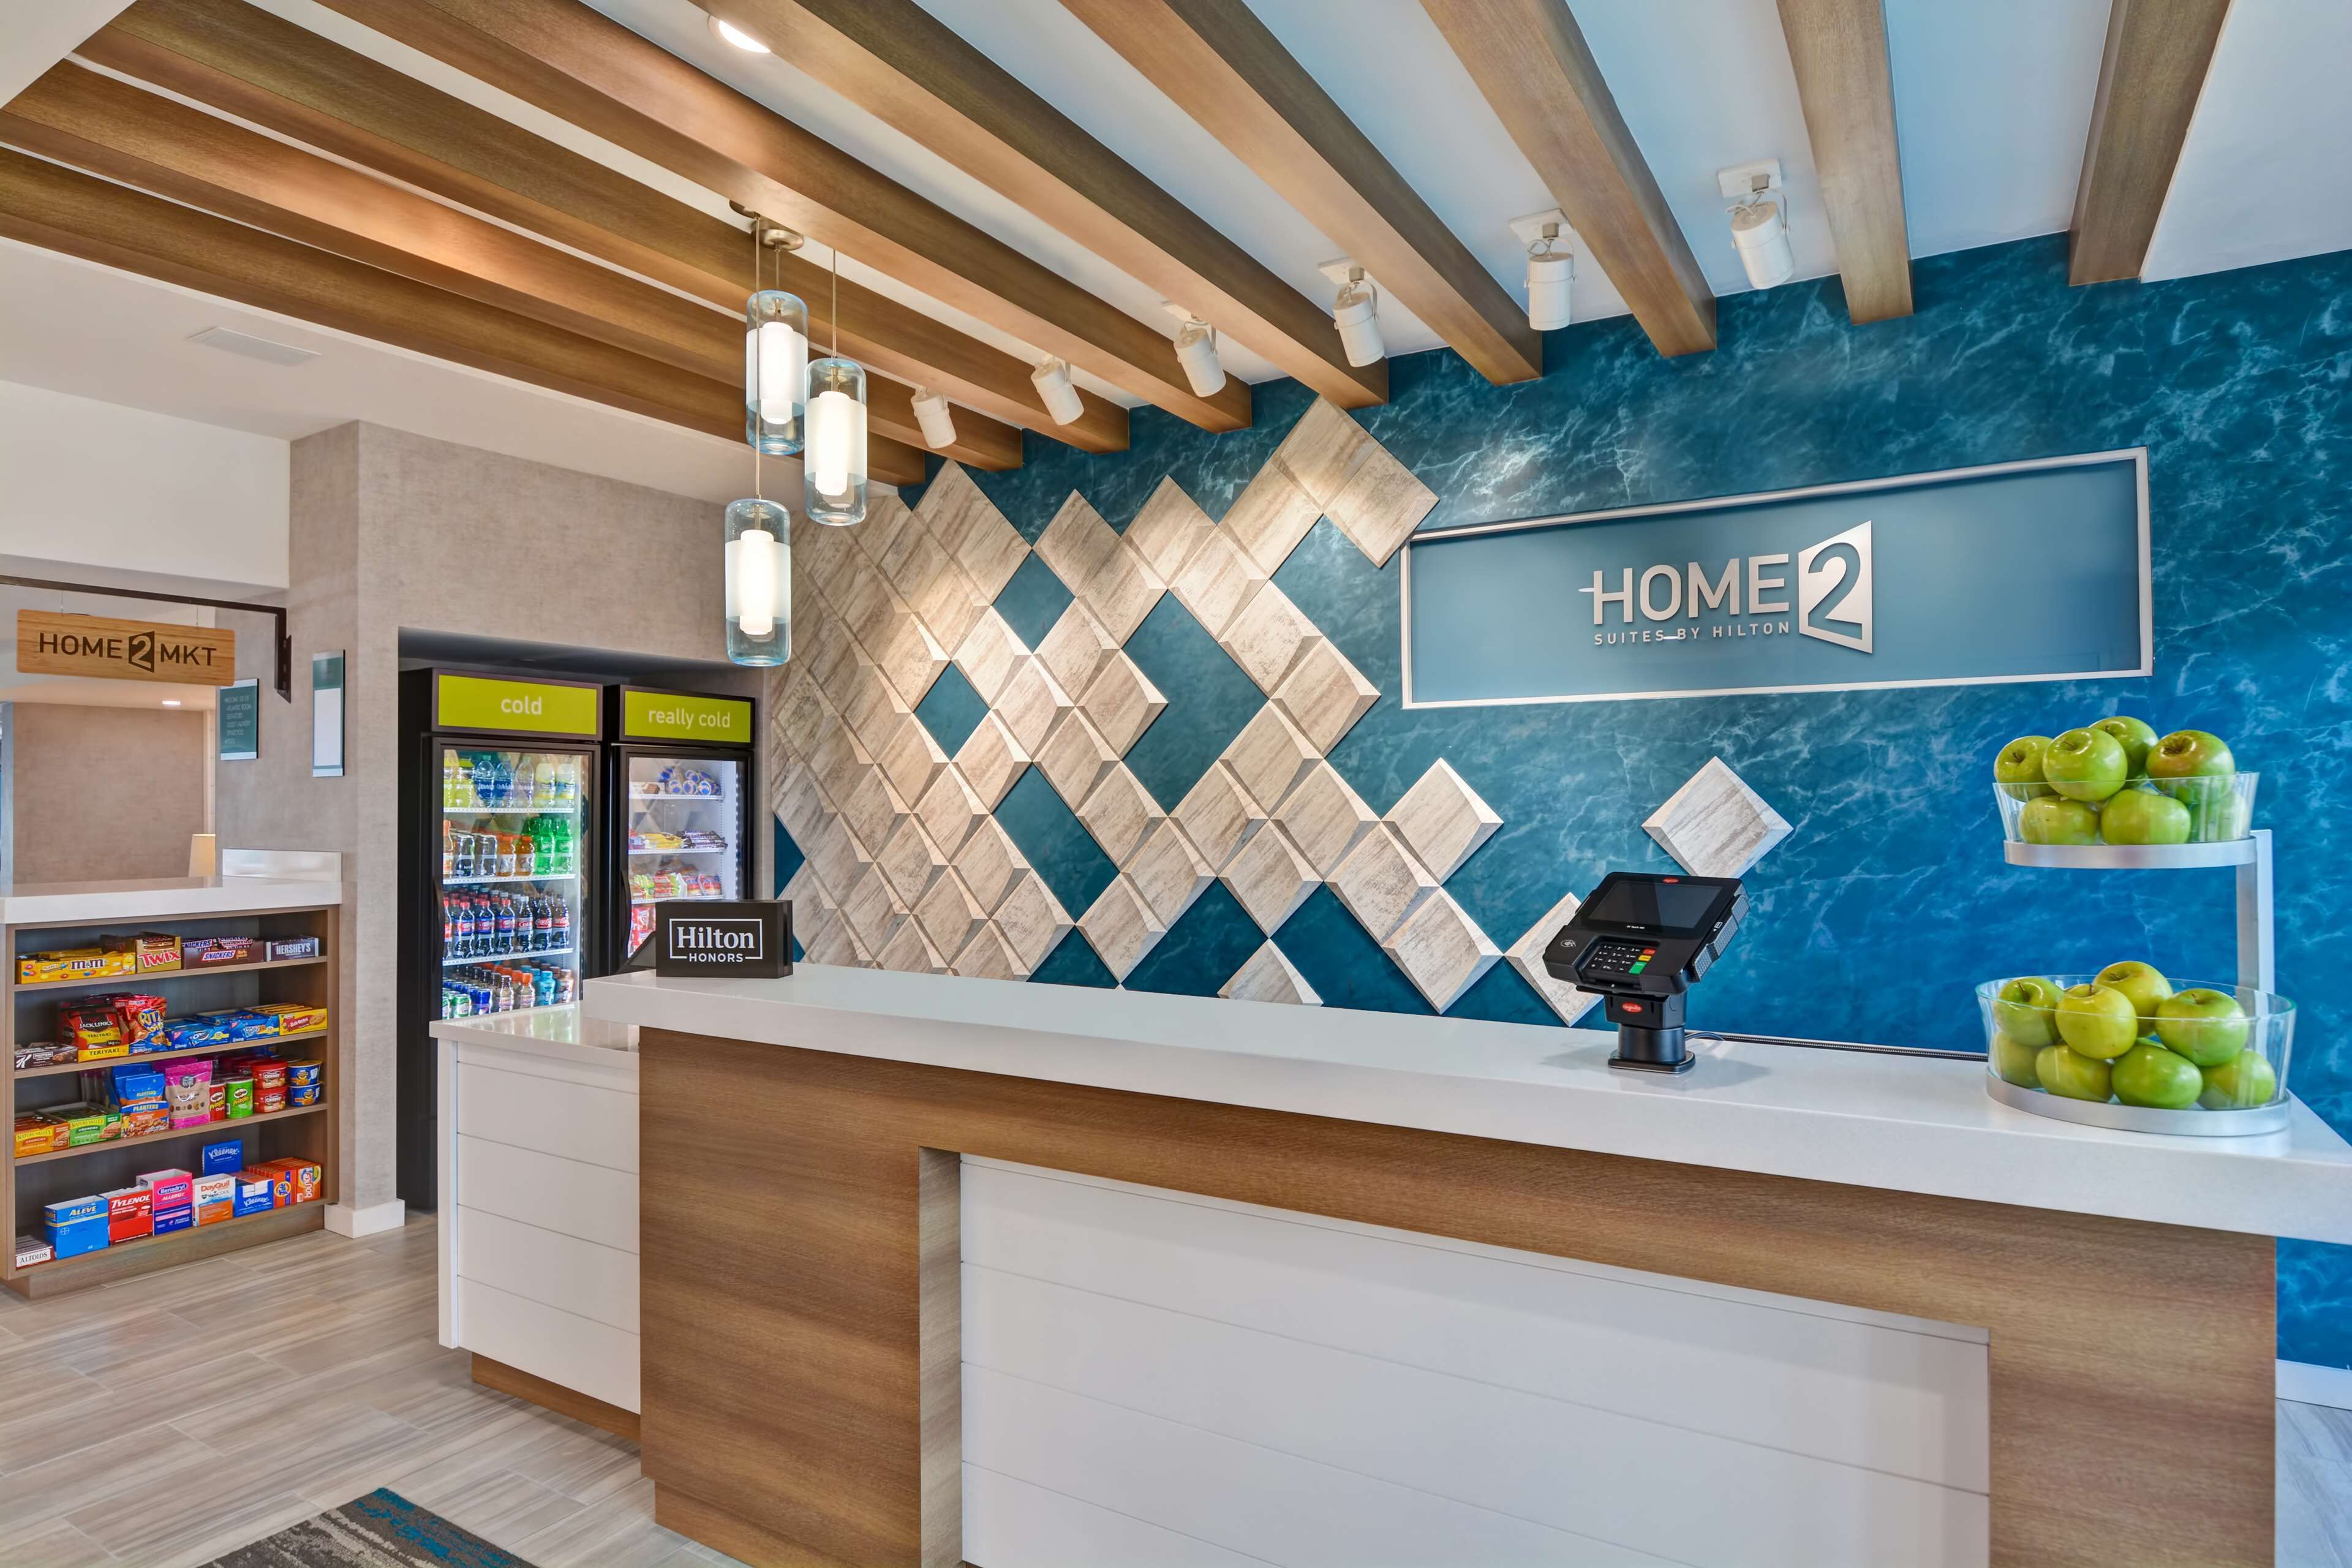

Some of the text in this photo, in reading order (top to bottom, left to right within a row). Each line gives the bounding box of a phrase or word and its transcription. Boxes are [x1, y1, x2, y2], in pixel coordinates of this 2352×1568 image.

[1593, 537, 1864, 643] HOME 2
[1594, 621, 1790, 646] SUITES BY HILTON
[39, 633, 217, 670] HOME 2 MKT
[500, 695, 543, 715] cold
[648, 707, 731, 729] really cold
[677, 926, 755, 949] Hilton
[203, 951, 235, 960] SNICKERS
[276, 943, 311, 955] HERSHEY'S
[688, 953, 744, 963] HONORS
[208, 1148, 239, 1159] Kleenex
[160, 1183, 186, 1194] Benadryl
[201, 1179, 230, 1191] DayQuil
[279, 1183, 288, 1196] Tide
[111, 1194, 151, 1209] TYLENOL
[162, 1192, 185, 1200] ALLERGY
[69, 1205, 97, 1216] ALEVE
[20, 1251, 48, 1264] ALTOIDS
